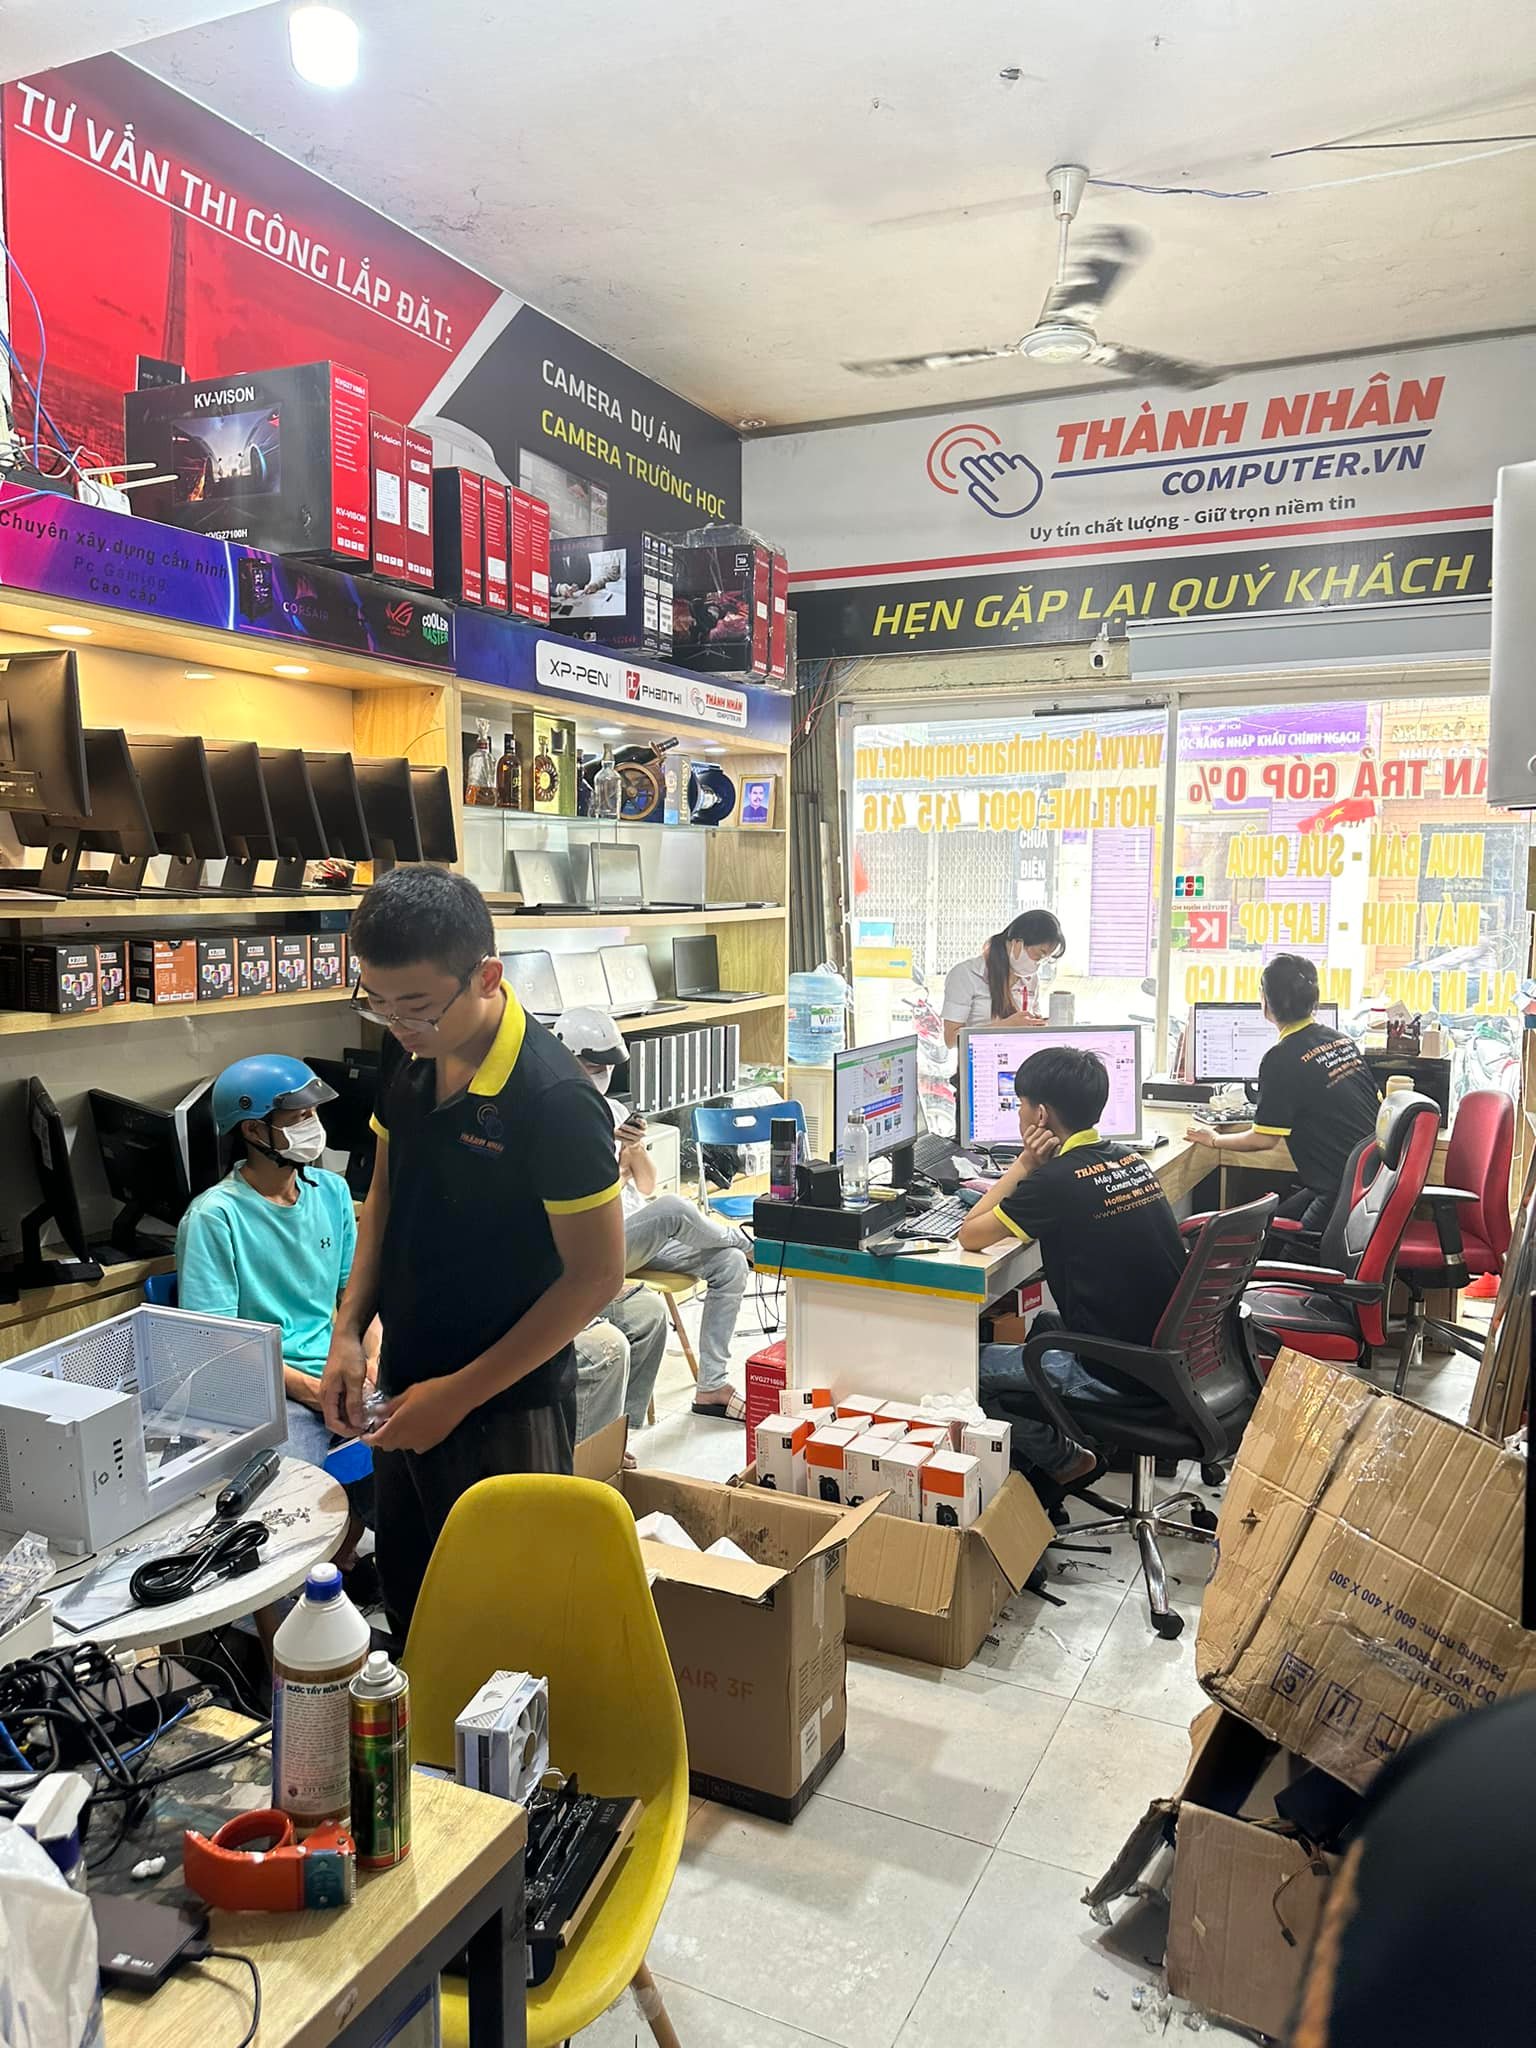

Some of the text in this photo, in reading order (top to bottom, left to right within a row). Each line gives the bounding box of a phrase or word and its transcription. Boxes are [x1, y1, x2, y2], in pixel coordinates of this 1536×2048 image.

[16, 82, 76, 143] TƯ
[86, 122, 170, 196] VẤN
[180, 169, 237, 230] THI
[245, 212, 328, 280] CÔNG
[336, 257, 391, 308] LẮP
[194, 386, 255, 409] KV-VISON
[542, 359, 681, 454] CAMERA DỰ ÁN
[1055, 372, 1446, 466] THÀNH NHÂN
[541, 409, 726, 520] CAMERA TRƯỜNG HỌC
[1162, 443, 1426, 498] COMPUTER.VN
[0, 509, 69, 541] Chuyên
[1029, 526, 1052, 542] Uy
[1056, 524, 1080, 541] tín
[1084, 515, 1124, 537] chất
[1127, 511, 1180, 536] lượng
[1194, 505, 1227, 526] Giữ
[1229, 502, 1271, 524] trọn
[1275, 494, 1324, 518] niềm
[1328, 493, 1356, 512] tin
[89, 577, 121, 596] Cao
[872, 553, 1475, 640] HẸN GẶP LẠI QUÝ KHÁCH
[283, 601, 329, 622] CORSAIR
[422, 612, 449, 632] COOLER
[550, 658, 609, 688] XP-PEN
[680, 759, 690, 821] Hennessy
[1329, 1569, 1350, 1585] 300
[1360, 1588, 1382, 1608] 400
[1395, 1609, 1417, 1629] 600
[1418, 1622, 1458, 1649] norm:
[1394, 1636, 1497, 1703] DO NOT THROW
[1457, 1641, 1508, 1683] Packing
[679, 1665, 754, 1702] AIR 3F
